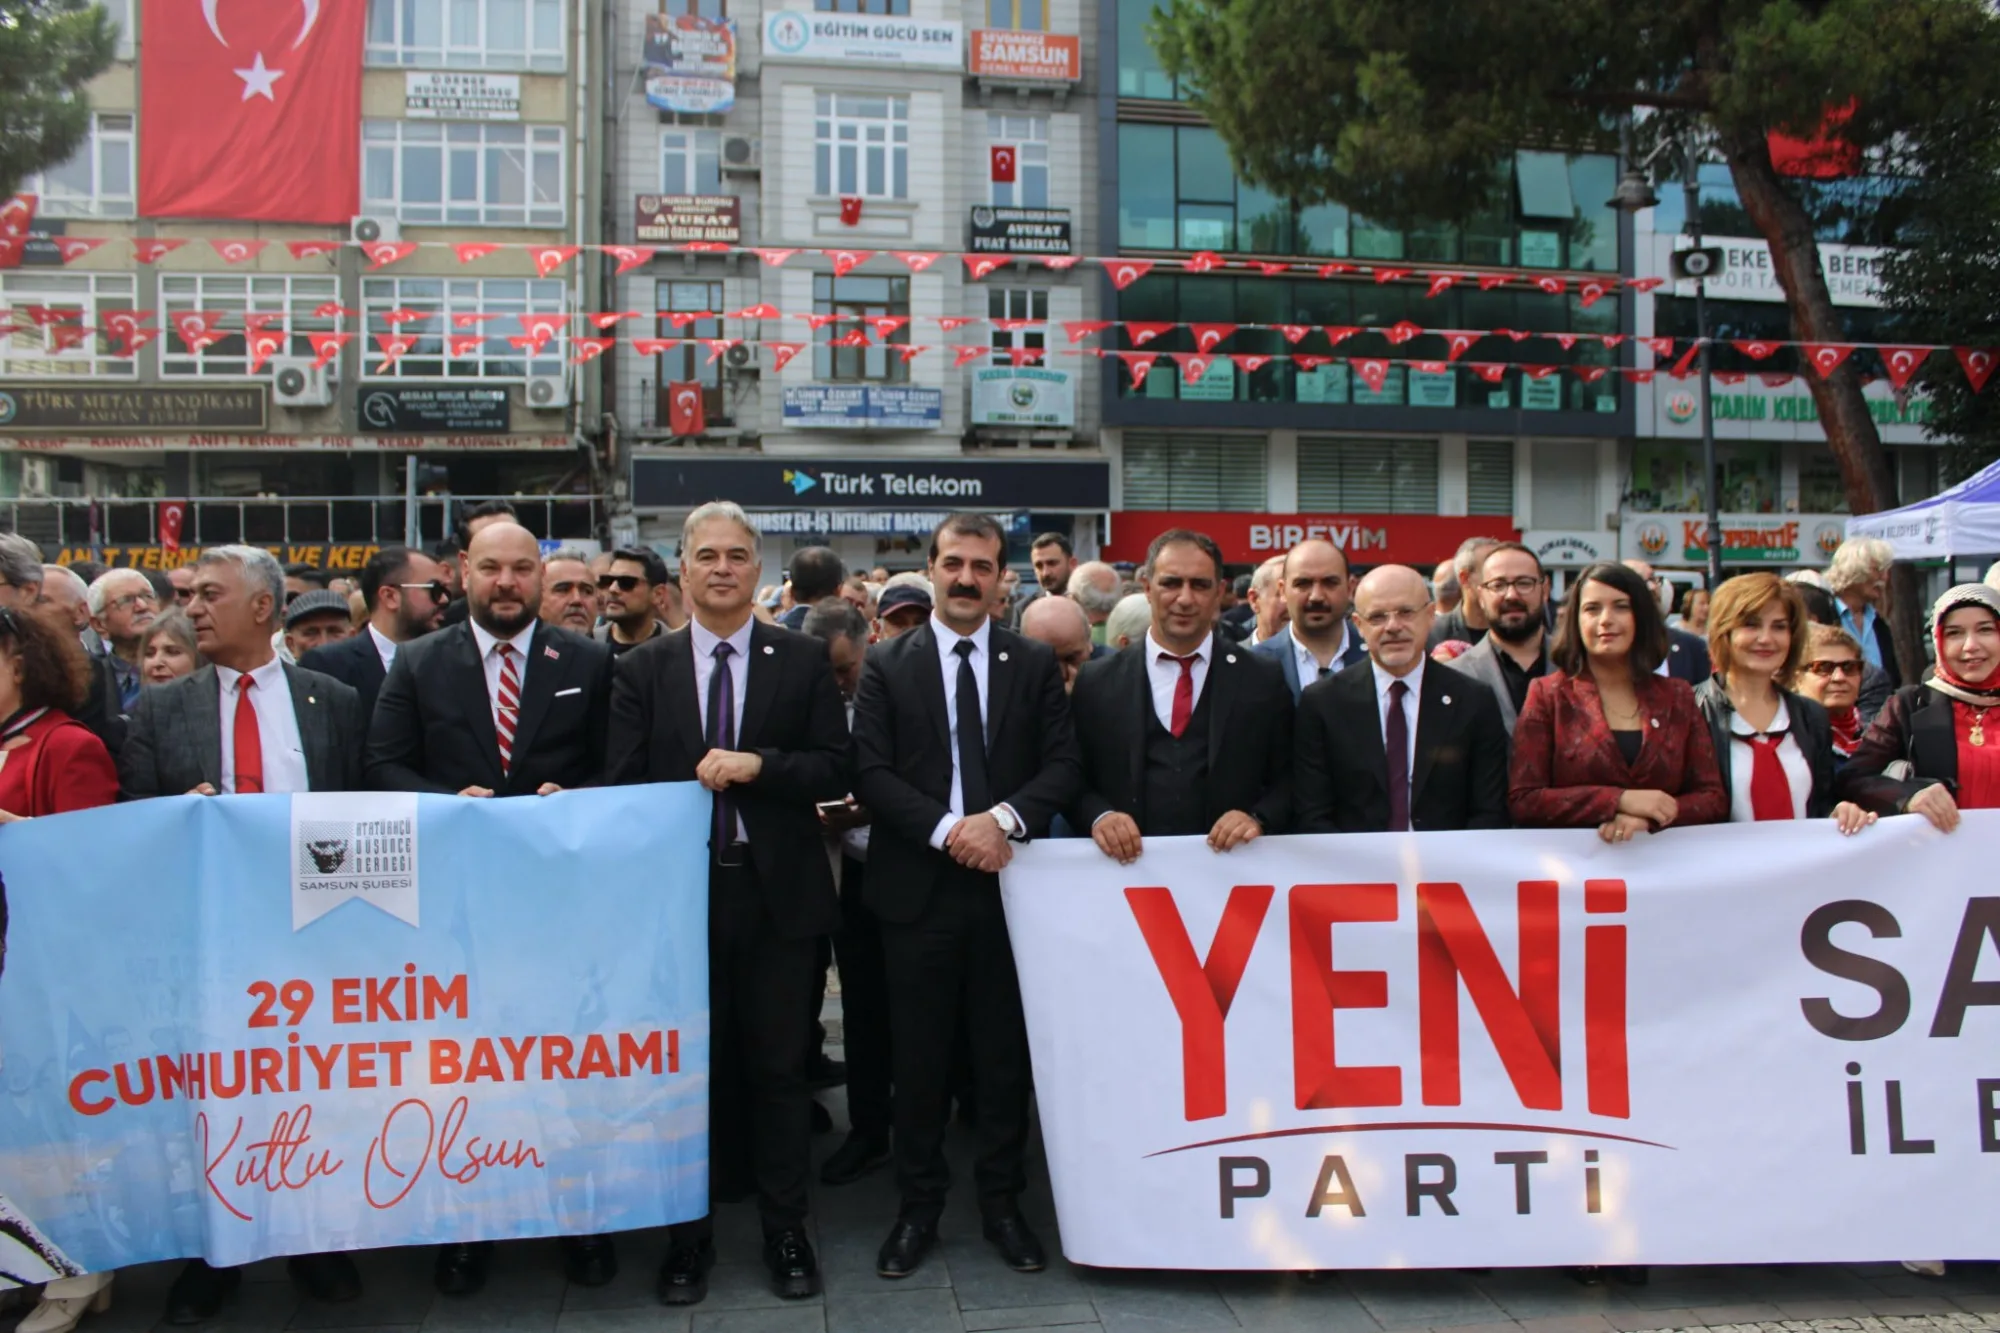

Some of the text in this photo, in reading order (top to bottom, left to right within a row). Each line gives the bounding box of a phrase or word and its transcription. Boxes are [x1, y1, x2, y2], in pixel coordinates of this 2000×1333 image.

[813, 21, 953, 43] EĞİTİM GÜCÜ SEN
[979, 43, 1070, 64] SAMSUN
[654, 214, 732, 225] AVUKAT
[1007, 223, 1062, 236] AVUKAT
[1009, 237, 1069, 251] SARIKAYA
[1728, 249, 1877, 276] EKE BER
[23, 391, 253, 410] TÜRK METAL SENDİKASI
[1711, 394, 1766, 420] TARIM
[188, 434, 229, 447] ANIT
[820, 473, 982, 496] Türk Telekom
[831, 510, 891, 531] İNTERNET
[894, 512, 949, 534] BAŞVU
[55, 547, 121, 567] ANT
[126, 546, 205, 569] TERM
[288, 547, 324, 569] VE
[356, 836, 411, 855] DÜŞÜNCE
[356, 855, 411, 873] DERNEĞİ
[299, 879, 412, 891] SAMSUN ŞUBESİ
[246, 963, 468, 1028] 29 EKİM
[428, 1029, 680, 1084] BAYRAMI
[195, 1096, 544, 1221] Kutlu Olsun
